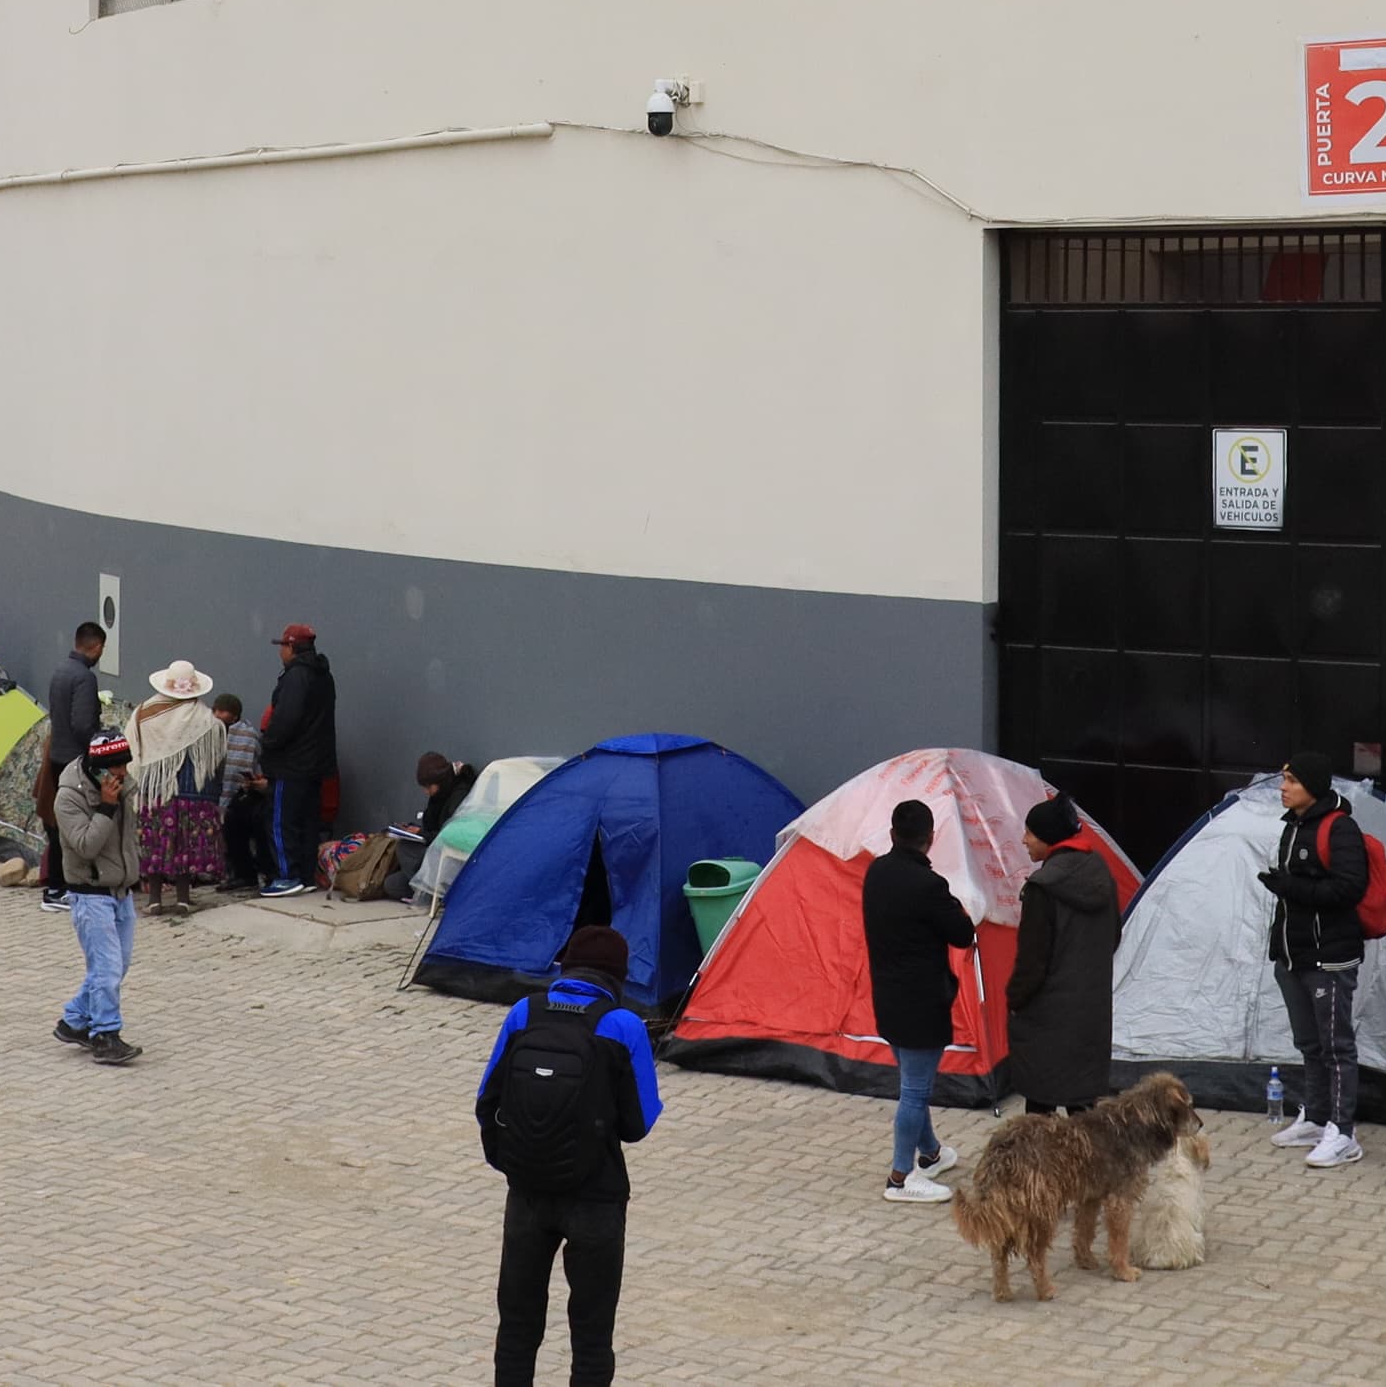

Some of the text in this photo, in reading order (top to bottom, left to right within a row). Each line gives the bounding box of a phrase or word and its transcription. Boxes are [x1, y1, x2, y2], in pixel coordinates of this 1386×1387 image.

[1315, 82, 1332, 166] PUERTA
[1322, 170, 1377, 185] CURVA
[1219, 486, 1279, 497] ENTRADA Y
[1221, 499, 1277, 510] SALIDA DE
[1219, 511, 1279, 522] VEHICULOS
